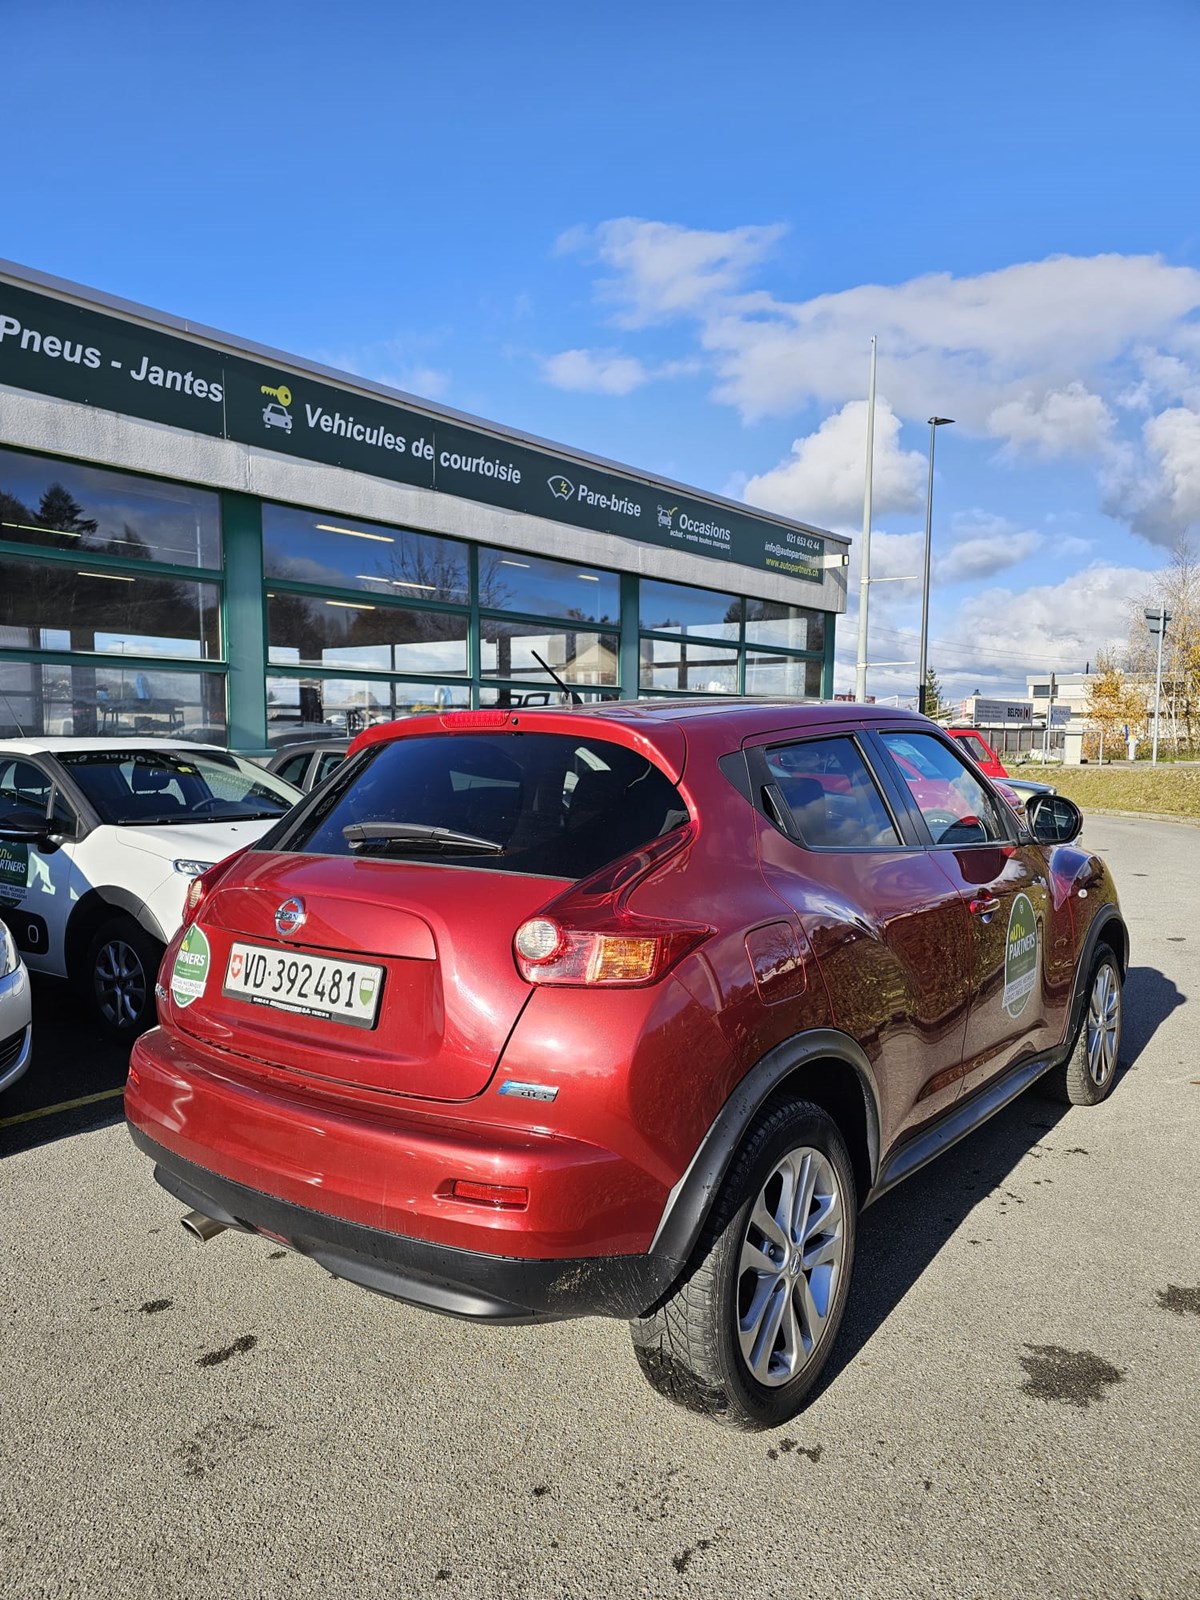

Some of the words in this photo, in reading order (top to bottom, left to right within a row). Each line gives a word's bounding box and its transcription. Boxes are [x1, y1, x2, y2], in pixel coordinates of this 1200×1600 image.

[0, 314, 101, 369] Pneus
[130, 356, 223, 402] Jantes
[305, 403, 406, 453] Vehicules
[411, 438, 434, 460] de
[439, 451, 522, 484] courtoisie
[577, 484, 642, 517] Pare-brise
[679, 514, 730, 541] Occasions
[786, 533, 796, 544] 021
[797, 537, 806, 547] 653
[806, 539, 814, 549] 42
[814, 542, 820, 550] 44
[766, 558, 818, 577] www.autopartners.ch
[1007, 706, 1024, 719] BELFOR
[0, 858, 26, 874] RTNERS
[1008, 932, 1036, 960] PARTNERS
